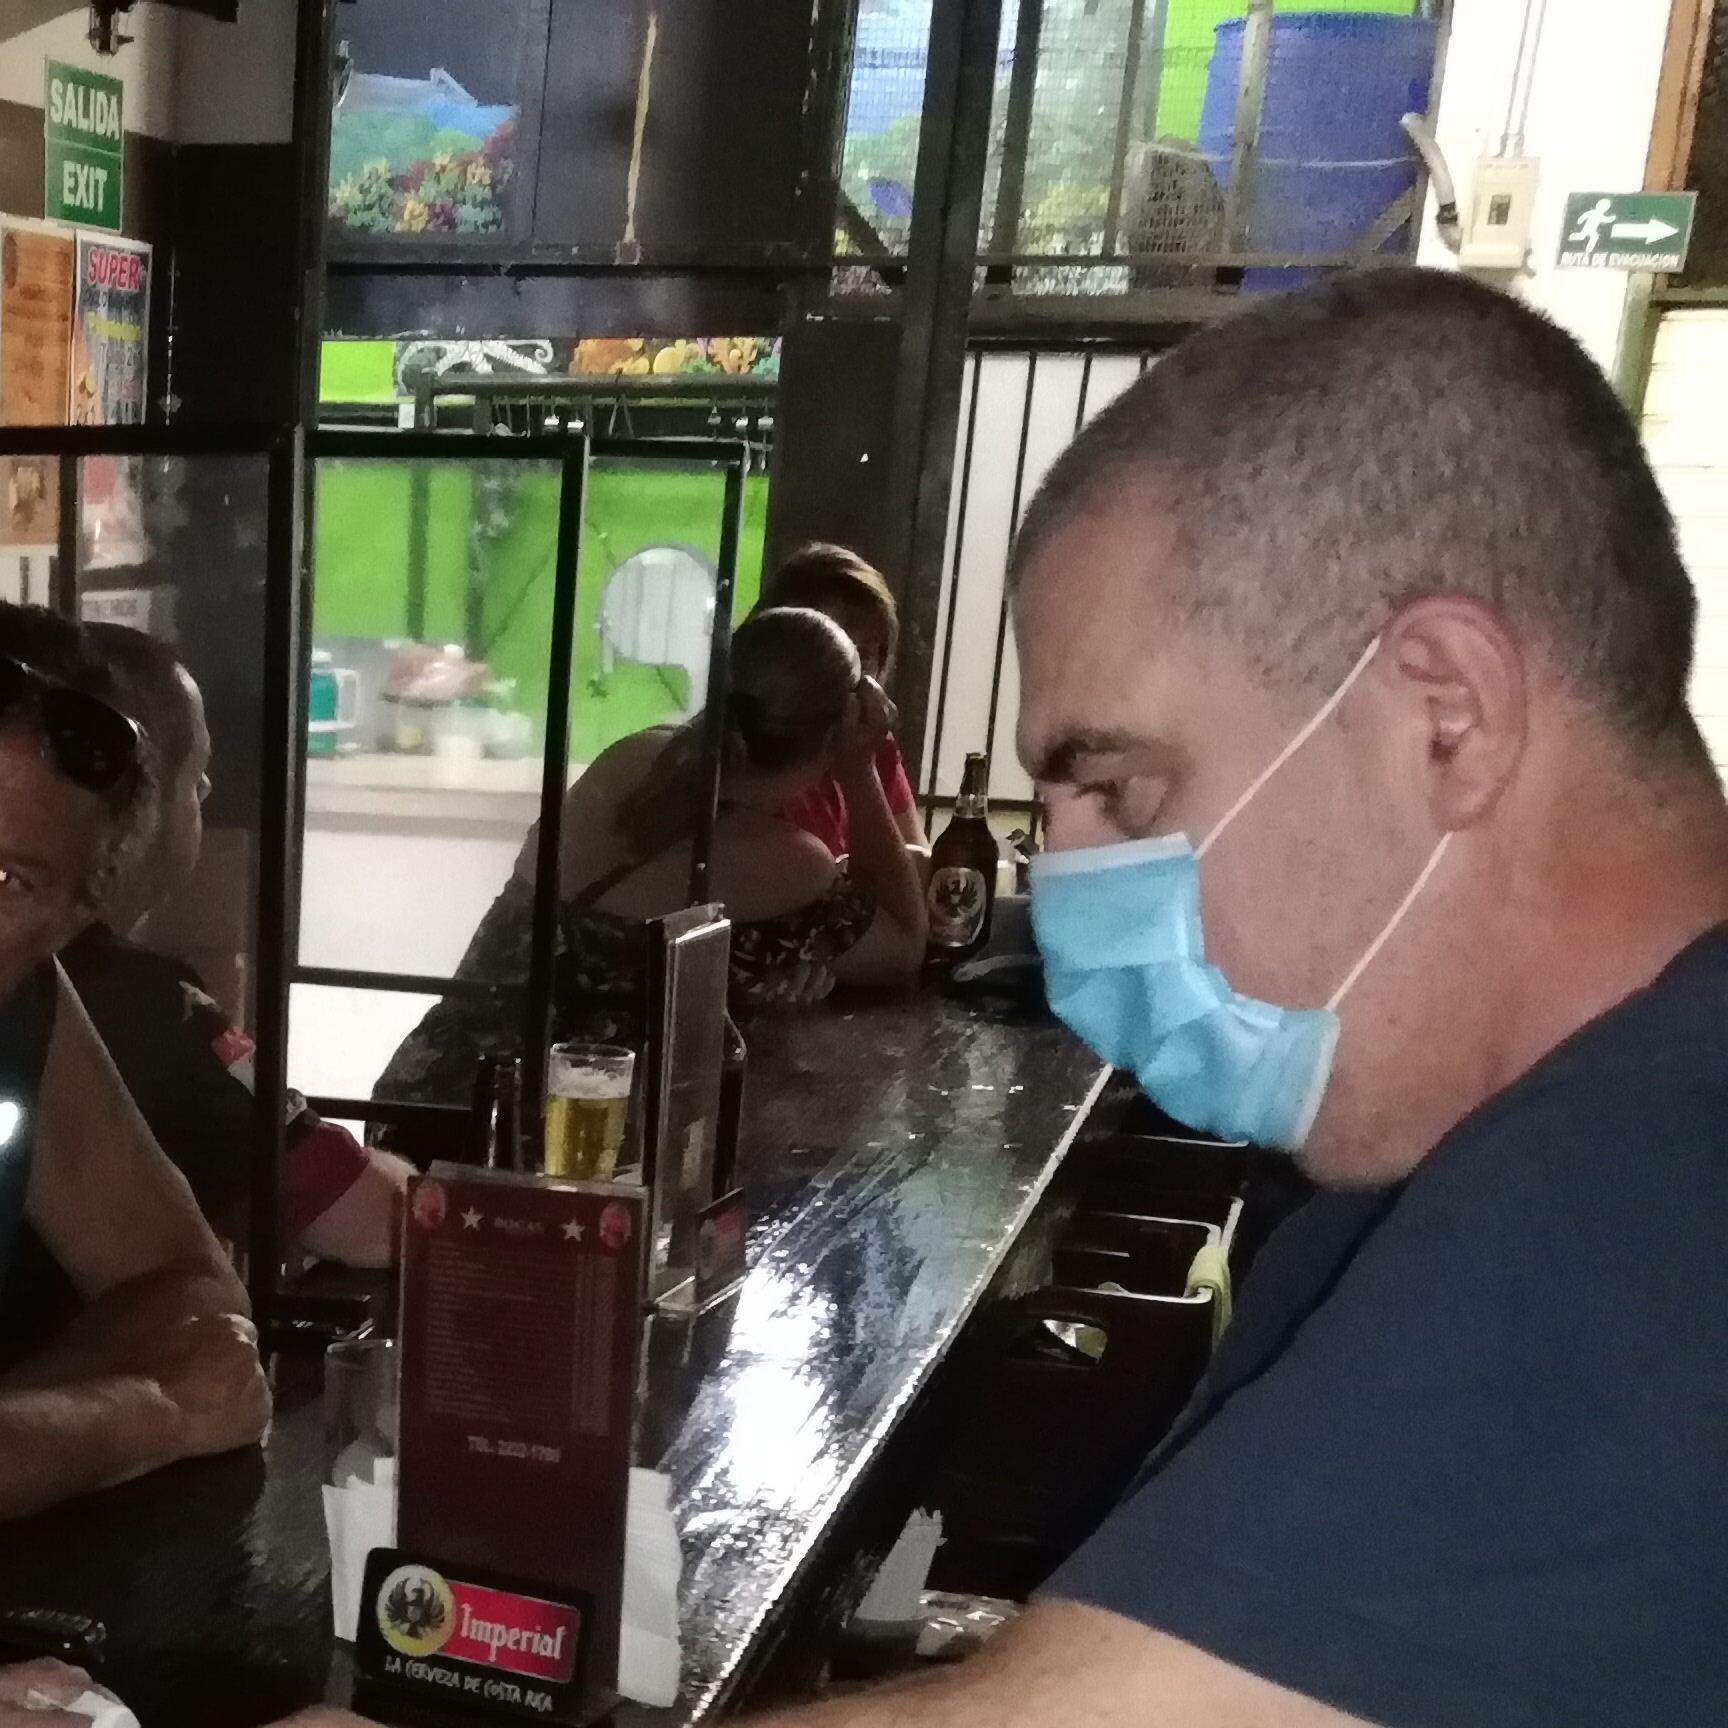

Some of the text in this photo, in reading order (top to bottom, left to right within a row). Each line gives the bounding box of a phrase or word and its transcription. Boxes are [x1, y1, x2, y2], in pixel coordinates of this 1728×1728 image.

[50, 78, 120, 140] SALIDA
[63, 160, 108, 212] EXIT
[87, 246, 142, 292] SUPER
[1560, 252, 1590, 266] RUTA
[1591, 253, 1607, 267] DE
[459, 1603, 567, 1662] Imperial
[384, 1655, 553, 1713] LA CERVEZA DE COSTA RICA
